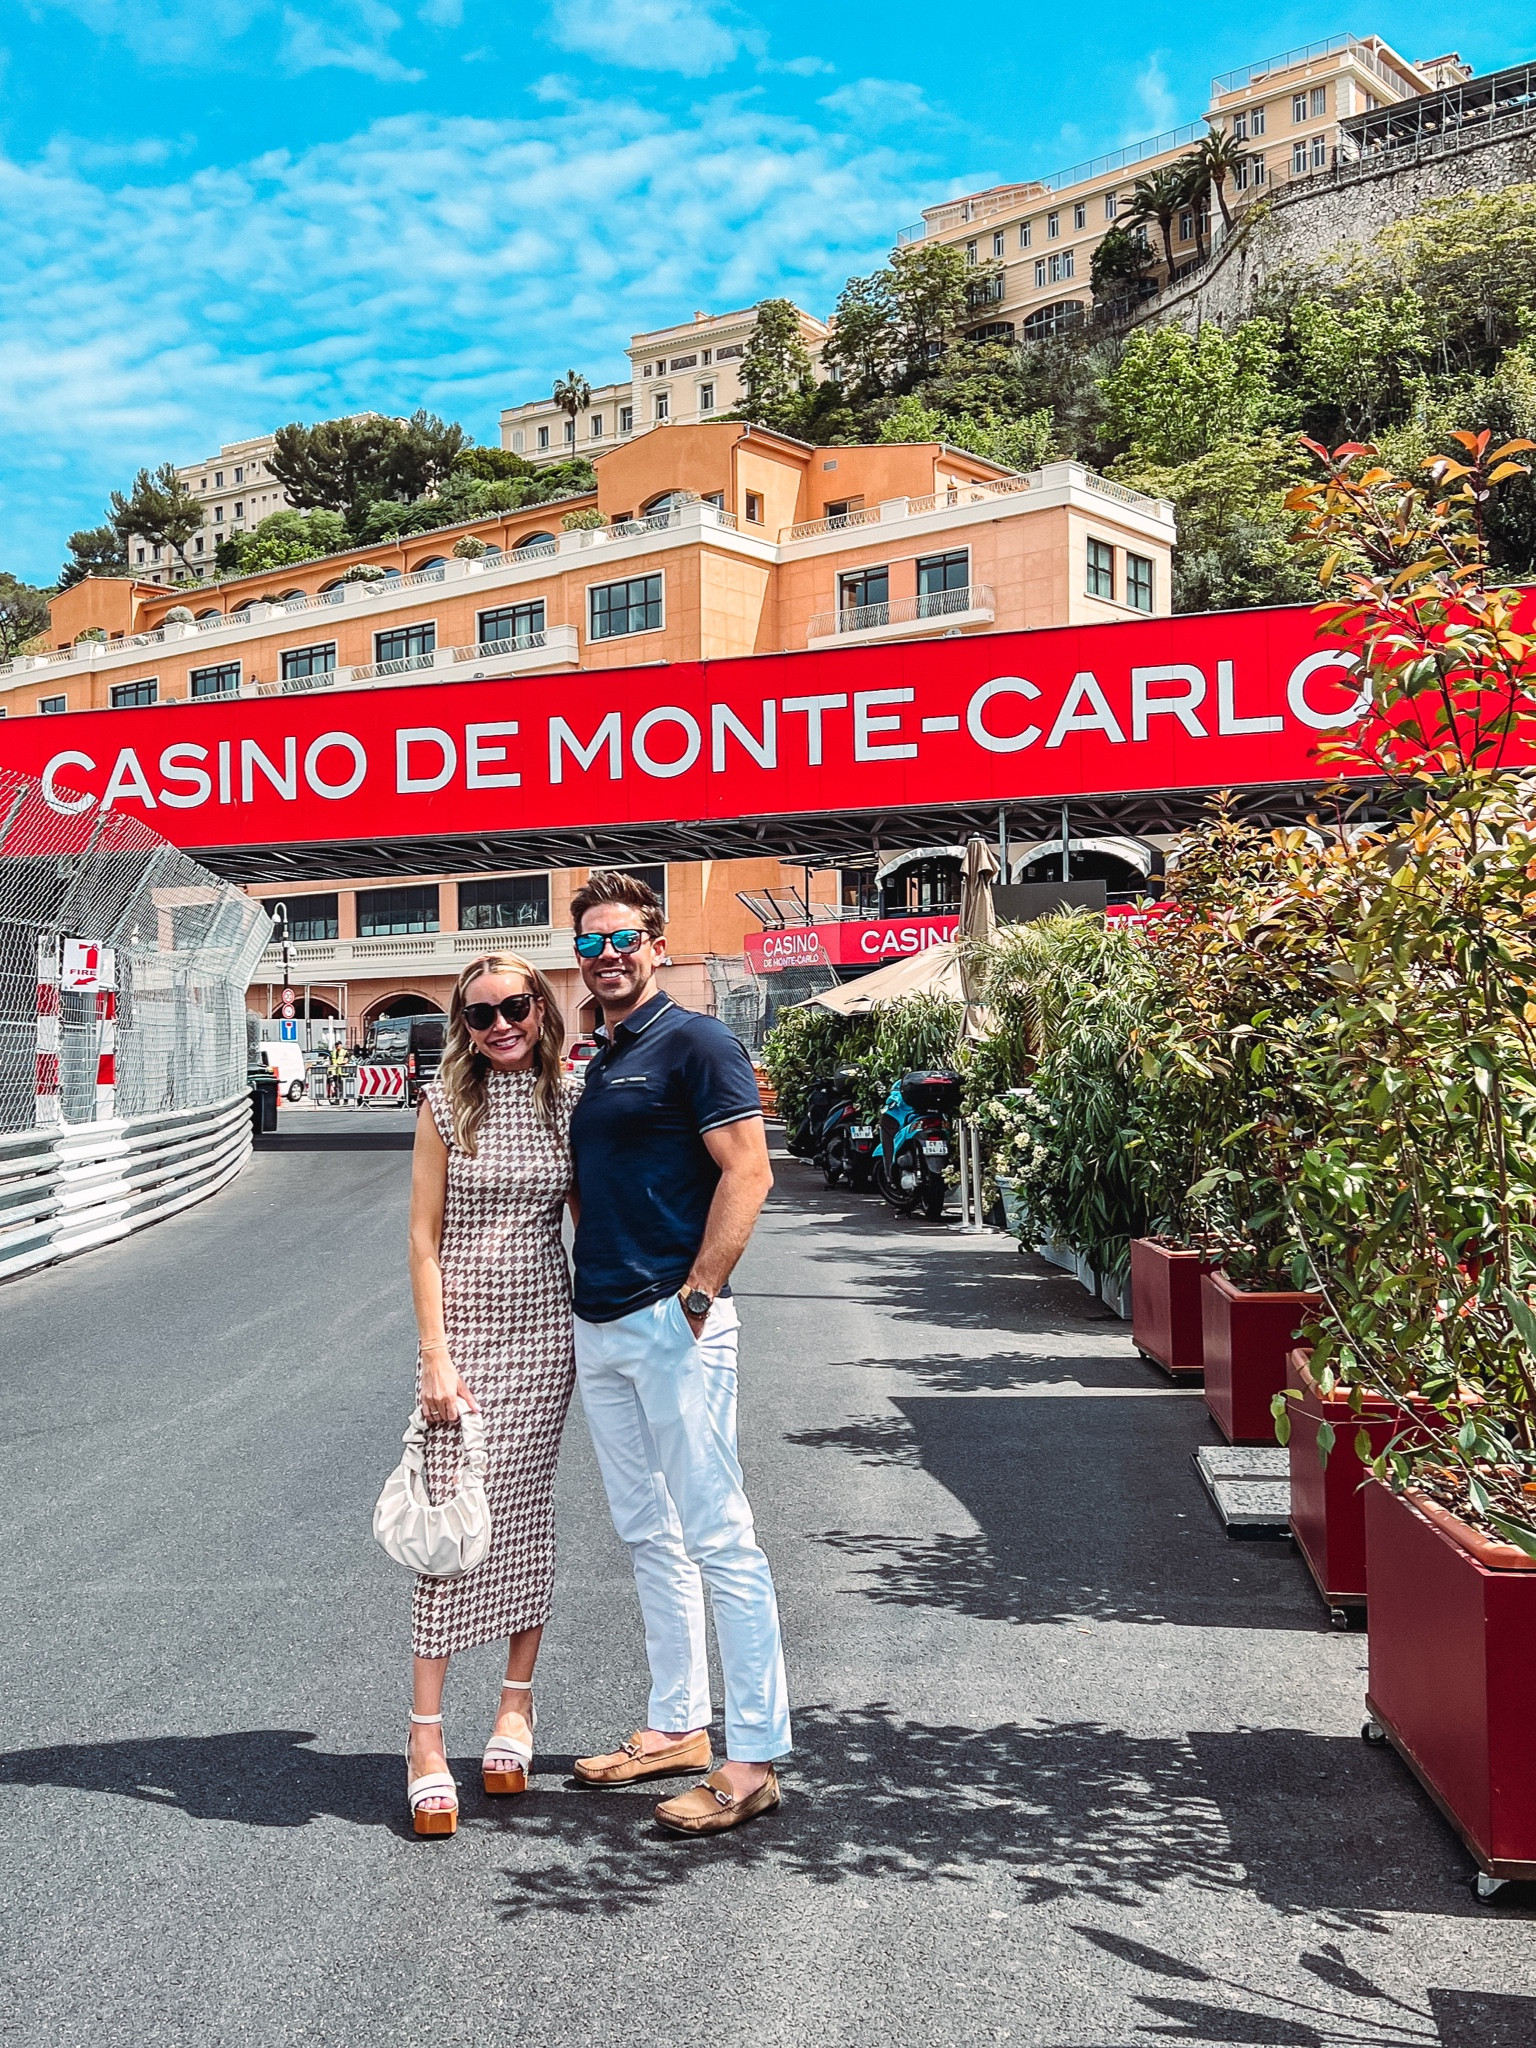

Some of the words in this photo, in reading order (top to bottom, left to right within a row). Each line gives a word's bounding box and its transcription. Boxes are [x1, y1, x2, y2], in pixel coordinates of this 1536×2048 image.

[41, 731, 367, 816] CASINO
[395, 720, 522, 795] DE
[548, 649, 1374, 785] MONTE-CARLO
[763, 932, 818, 957] CASINO
[763, 958, 773, 967] DE
[773, 953, 818, 967] MONTE-CARLO
